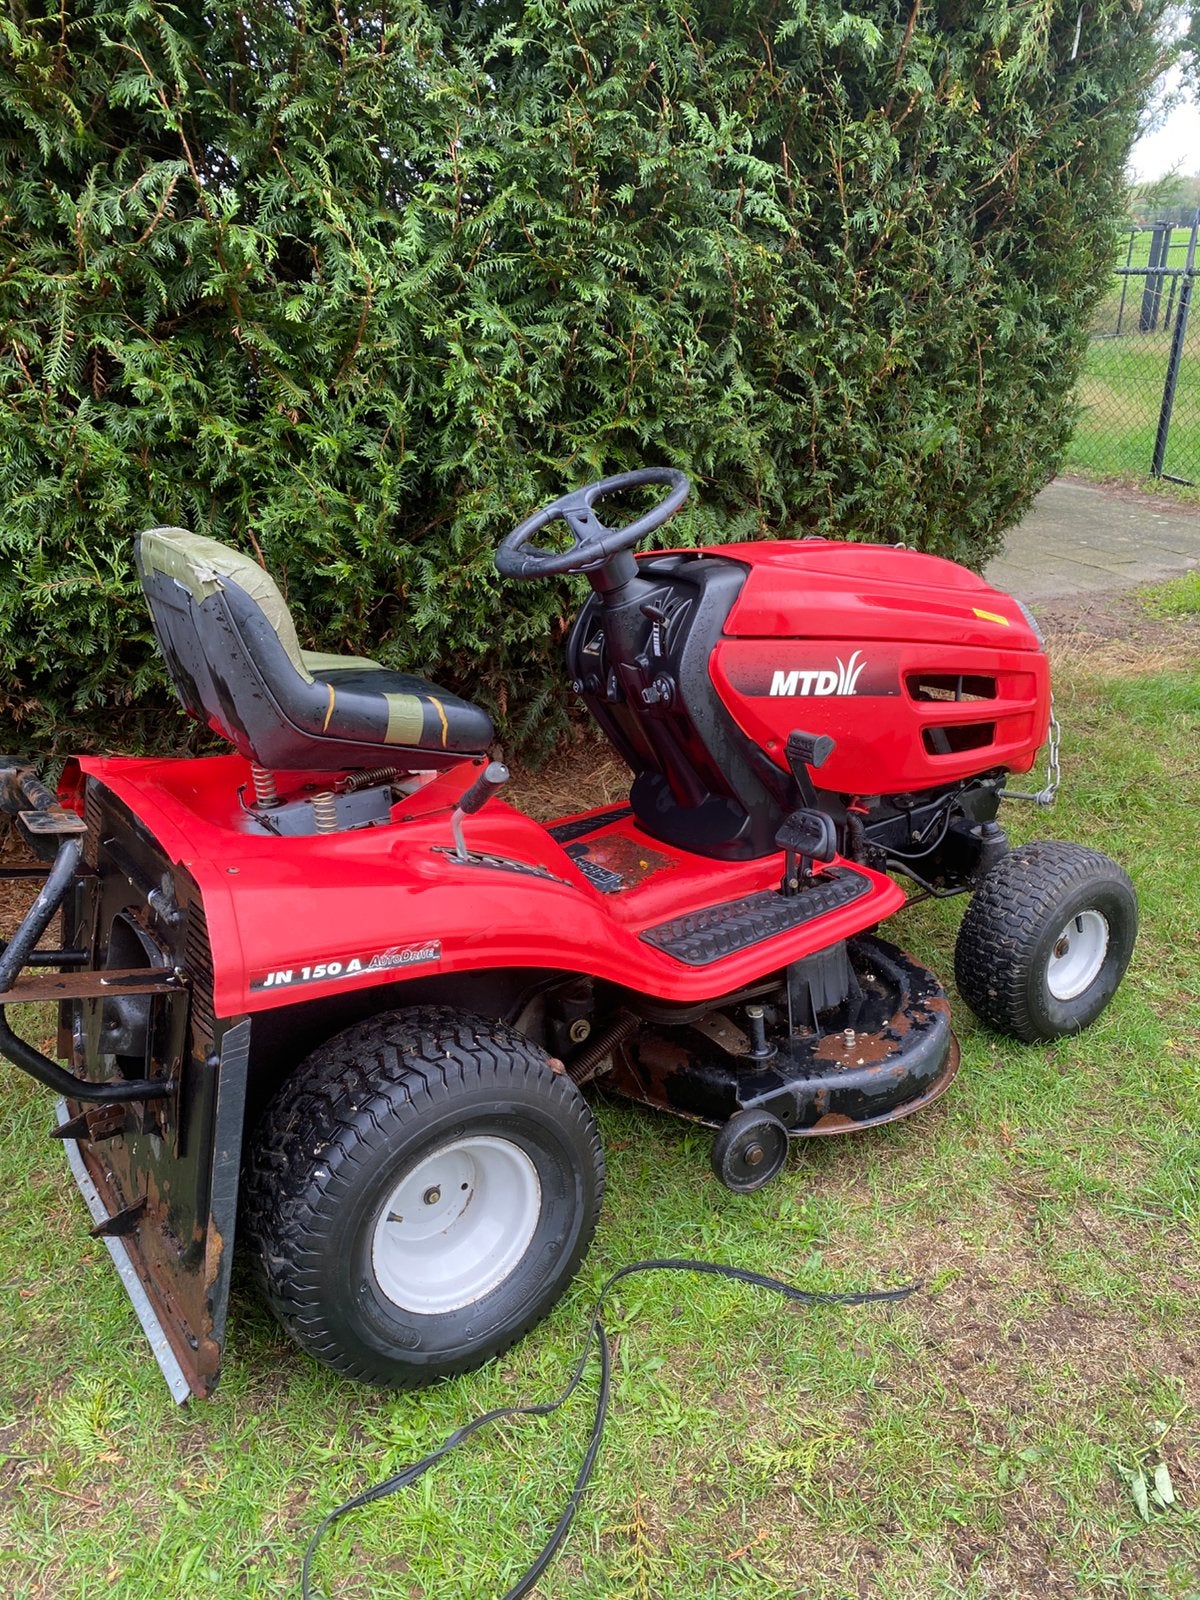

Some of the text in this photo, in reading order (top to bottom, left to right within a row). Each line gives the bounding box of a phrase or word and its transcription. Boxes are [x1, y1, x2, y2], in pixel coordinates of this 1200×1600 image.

[769, 670, 838, 696] MTD
[264, 970, 293, 987] JN
[301, 962, 342, 980] 150
[346, 958, 362, 973] A
